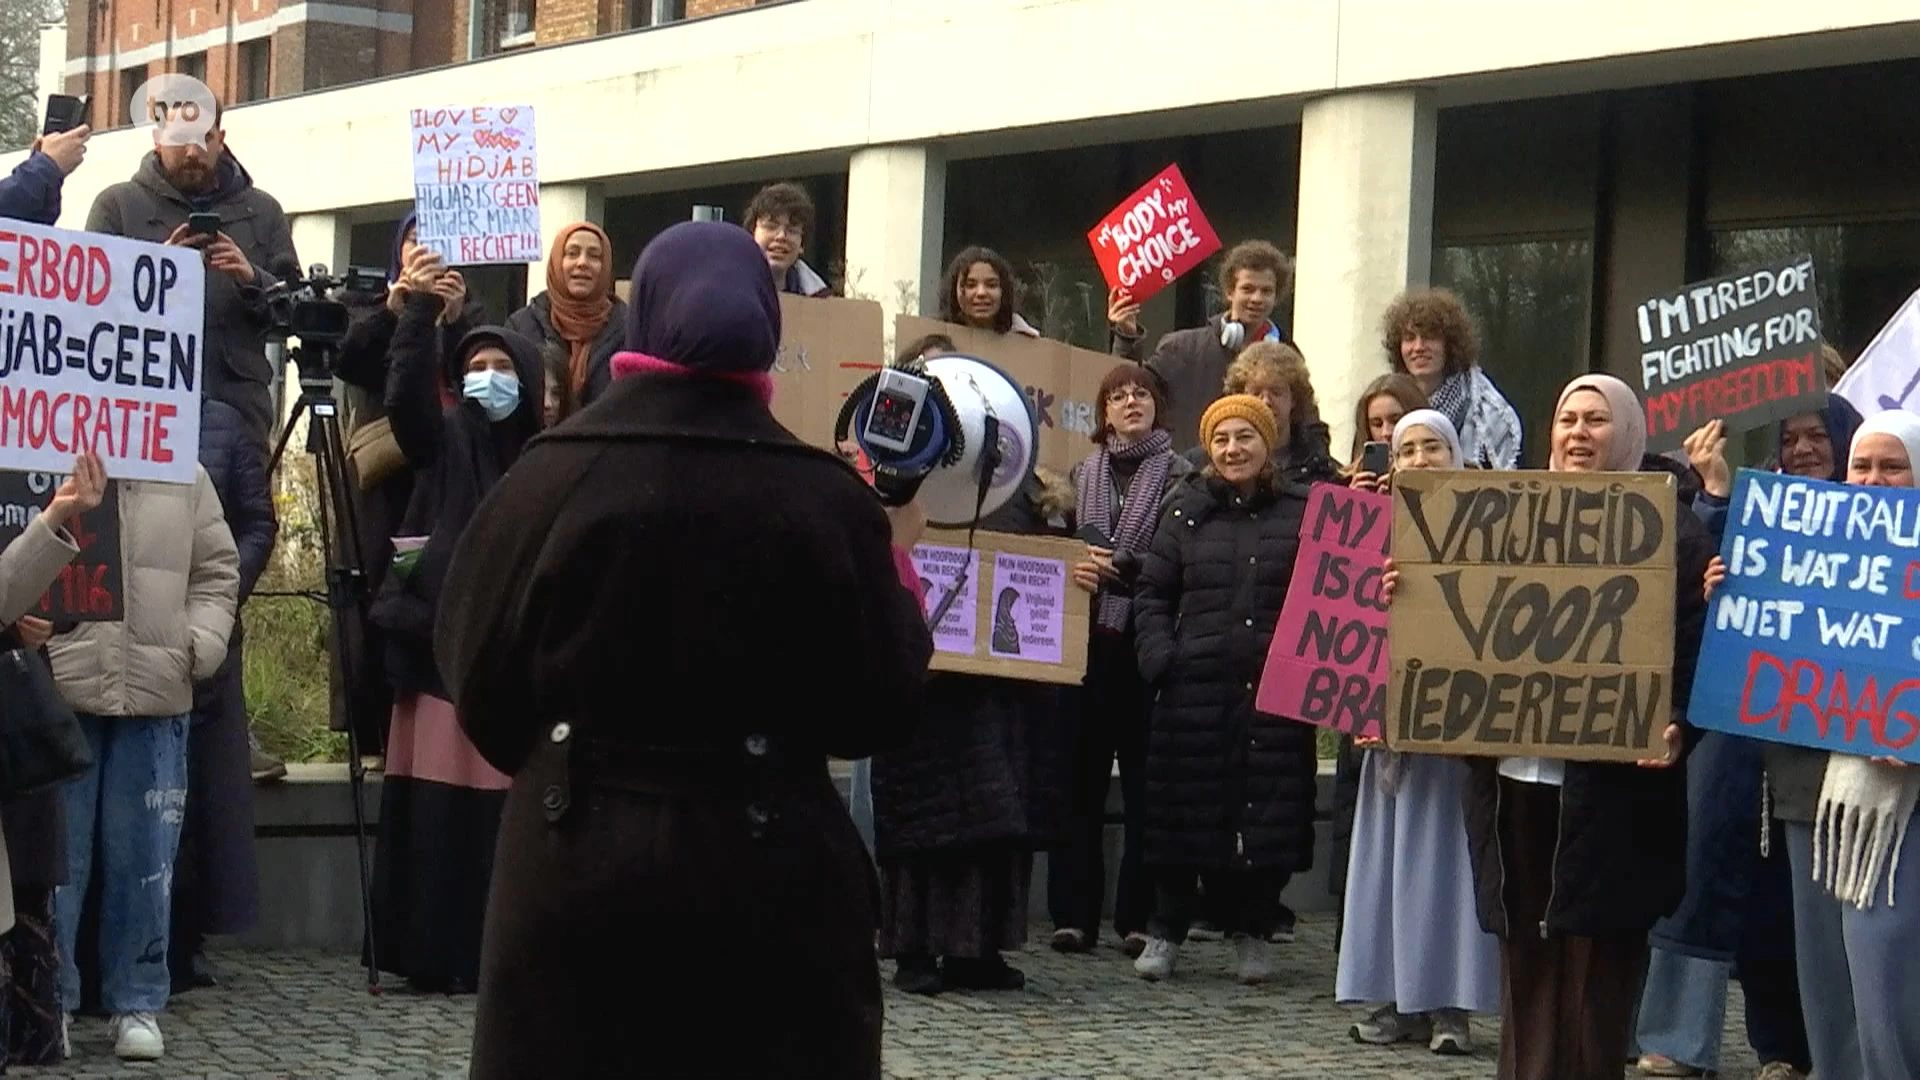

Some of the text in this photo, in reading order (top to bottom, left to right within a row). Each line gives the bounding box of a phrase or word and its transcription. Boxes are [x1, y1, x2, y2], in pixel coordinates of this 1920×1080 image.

[417, 132, 460, 154] MY
[488, 208, 538, 234] MAAR
[493, 182, 539, 208] GEEN
[1097, 188, 1188, 254] MY BODY MY
[1118, 217, 1200, 287] CHOICE
[133, 254, 178, 316] OP
[1637, 294, 1691, 344] I'M
[1776, 260, 1812, 297] OF
[1641, 307, 1817, 391] FIGHTING FOR
[1646, 352, 1816, 437] MY FREEDOM
[1312, 491, 1382, 549] MY
[1312, 551, 1350, 600] IS
[1729, 535, 1769, 577] IS
[1781, 544, 1849, 588] WAT
[1849, 554, 1892, 595] JE
[1025, 592, 1055, 608] Vrijheid
[1031, 623, 1048, 633] voor
[1433, 570, 1639, 665] VOOR
[1716, 594, 1804, 640] NIET
[1817, 607, 1902, 649] WAT
[1296, 609, 1387, 674] NOT
[1739, 650, 1920, 750] DRAAG
